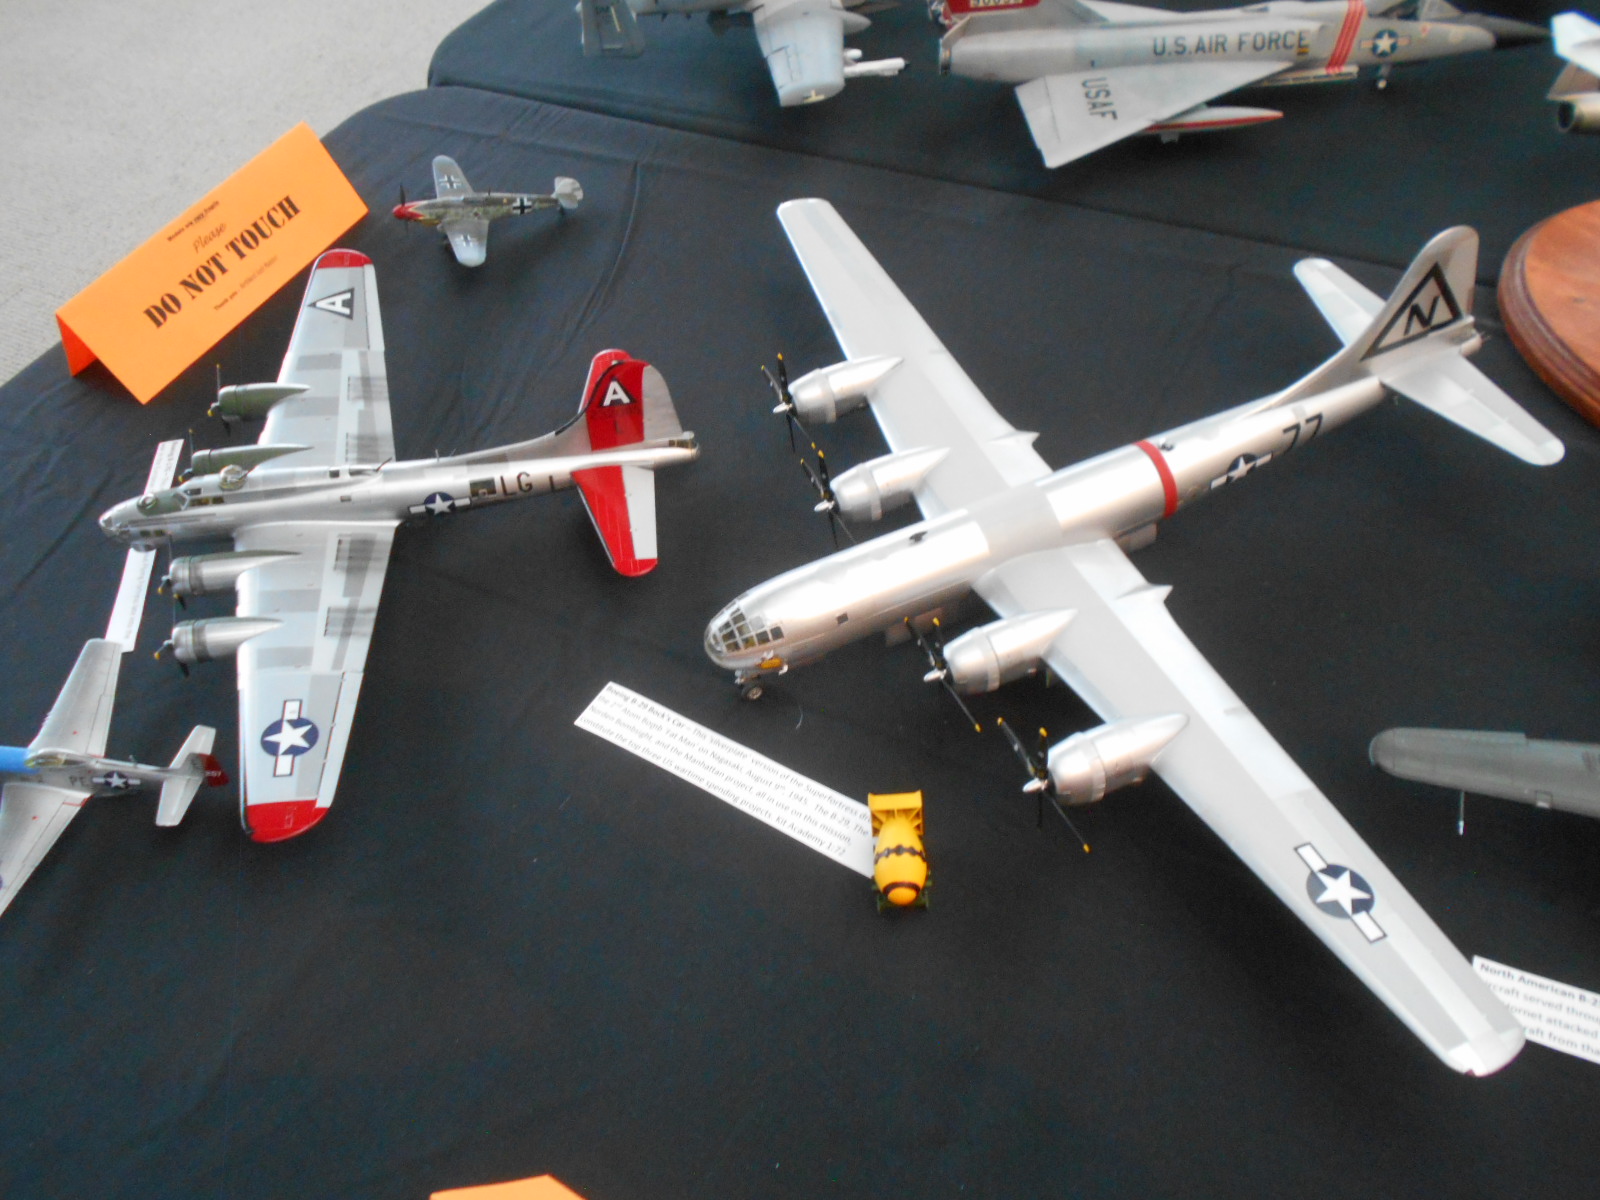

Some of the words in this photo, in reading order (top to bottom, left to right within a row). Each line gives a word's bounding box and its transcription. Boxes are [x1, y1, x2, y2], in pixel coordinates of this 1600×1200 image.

[1238, 30, 1311, 52] FORCE
[1082, 77, 1118, 120] USAF
[193, 223, 227, 253] Please
[143, 293, 182, 328] DO
[179, 252, 228, 300] NOT
[225, 195, 301, 260] TOUCH
[314, 292, 352, 316] A
[1404, 295, 1441, 336] N
[602, 380, 631, 406] A
[1283, 412, 1324, 452] 77
[500, 471, 533, 496] LG
[590, 705, 615, 721] Norden
[656, 739, 669, 749] and
[670, 746, 683, 756] the
[684, 752, 725, 777] Manhattan
[756, 789, 766, 798] all
[767, 795, 775, 803] in
[775, 801, 789, 811] use
[791, 808, 802, 818] on
[803, 814, 818, 826] this
[606, 685, 630, 701] Boeing
[631, 697, 648, 709] B-29
[648, 706, 672, 721] Bock's
[672, 718, 685, 728] Car
[692, 728, 707, 739] This
[750, 757, 779, 775] version
[780, 772, 789, 780] of
[790, 777, 803, 787] the
[804, 784, 859, 816] Superfortress
[580, 715, 614, 736] constitute
[615, 733, 627, 742] the
[628, 740, 641, 751] top
[642, 746, 662, 760] three
[663, 757, 673, 766] US
[674, 763, 705, 783] wartime
[704, 780, 740, 803] spending
[775, 816, 787, 826] Kit
[787, 822, 826, 847] Academy
[622, 707, 641, 720] Atom
[641, 717, 663, 732] Bomb
[698, 746, 709, 754] on
[746, 769, 773, 787] August
[814, 803, 829, 816] The
[854, 824, 870, 836] The
[1480, 963, 1515, 980] North
[1518, 975, 1576, 1000] American
[1523, 993, 1563, 1012] served
[1566, 1005, 1600, 1025] throu
[1546, 1015, 1598, 1039] attacked
[1548, 1032, 1578, 1049] from
